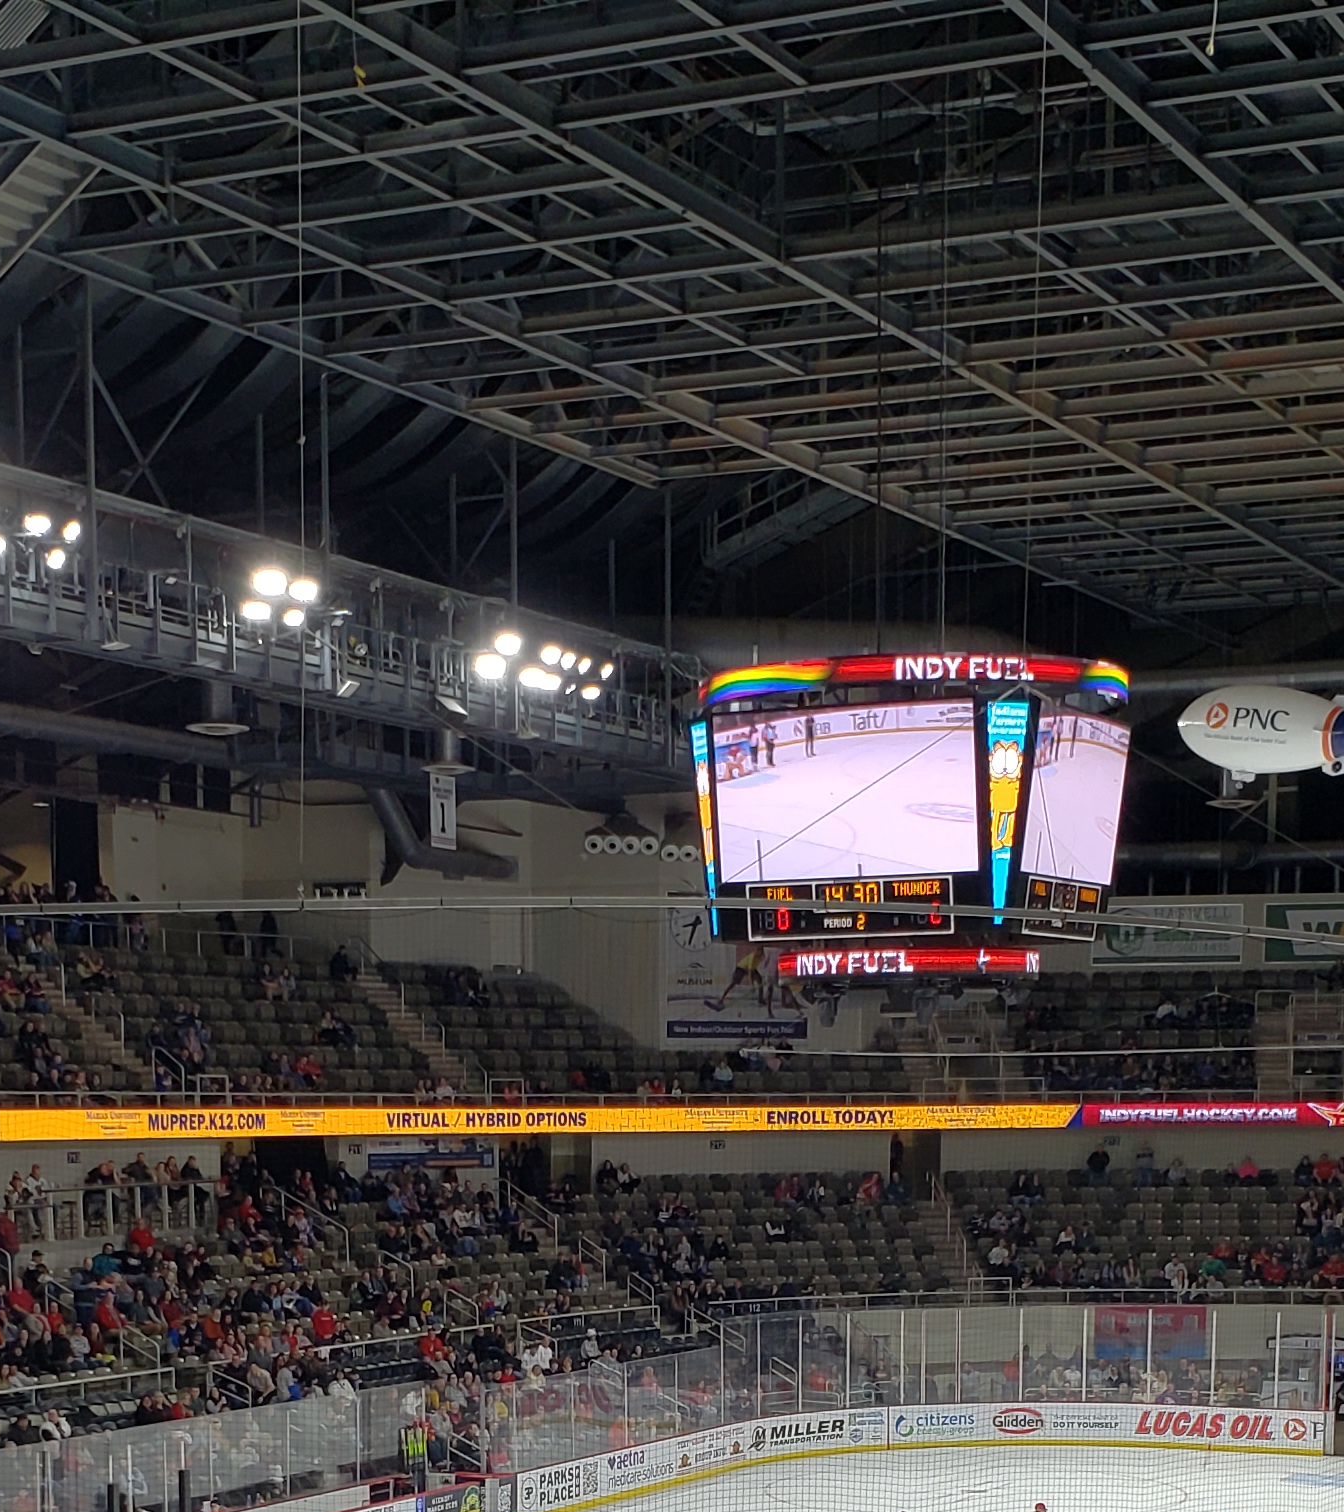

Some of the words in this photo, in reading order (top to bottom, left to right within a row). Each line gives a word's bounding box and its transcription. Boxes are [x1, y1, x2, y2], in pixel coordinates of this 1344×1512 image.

[895, 657, 962, 682] INDY
[969, 657, 1034, 682] FUEL
[1233, 706, 1290, 732] PNC
[440, 803, 446, 833] 1
[767, 887, 793, 901] FUEL
[892, 881, 941, 897] THUNDER
[777, 908, 789, 930] 0
[823, 917, 852, 928] PERIOD
[856, 912, 866, 930] 2
[796, 953, 843, 976] INDY
[847, 951, 914, 975] FUEL
[678, 978, 713, 986] MUSEUM
[148, 1113, 266, 1132] MUPREP.K12.COM
[386, 1112, 449, 1128] VIRTUAL
[466, 1112, 521, 1127] HYBRID
[526, 1111, 587, 1127] OPTIONS
[766, 1110, 829, 1125] ENROLL
[833, 1110, 894, 1124] TODAY!
[1100, 1108, 1297, 1123] INDYFUELHOCKEY.COM
[916, 1412, 975, 1427] citizens
[993, 1415, 1044, 1429] Glidden
[1053, 1421, 1065, 1429] DO
[1066, 1421, 1074, 1429] IT
[1077, 1421, 1119, 1429] YOURSELF
[1135, 1411, 1225, 1438] LUCAS
[1230, 1414, 1274, 1440] OIL
[770, 1419, 845, 1440] MILLER
[769, 1433, 844, 1448] TRANSPORTATION
[616, 1449, 645, 1470] aetna
[539, 1467, 574, 1489] PARKS
[608, 1469, 642, 1488] medicare
[642, 1461, 674, 1482] solutions
[539, 1484, 574, 1507] PLACE
